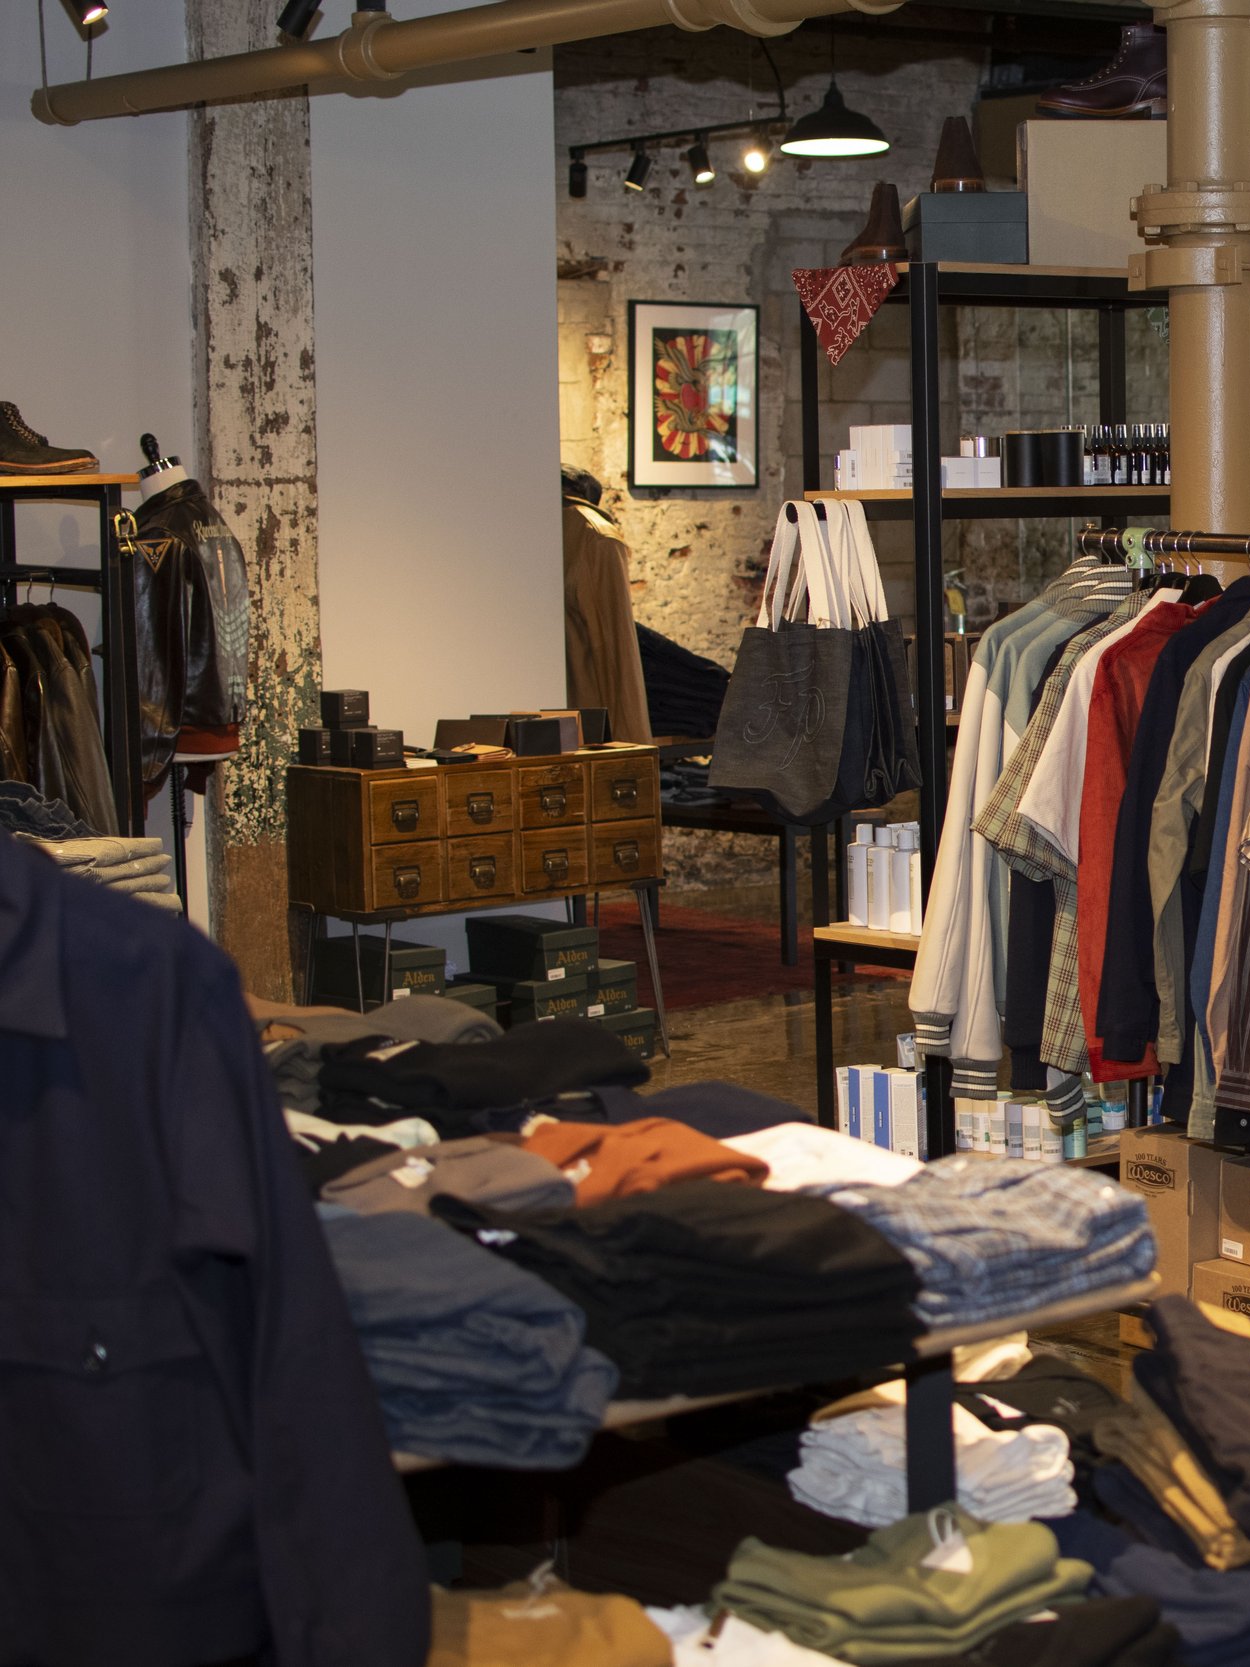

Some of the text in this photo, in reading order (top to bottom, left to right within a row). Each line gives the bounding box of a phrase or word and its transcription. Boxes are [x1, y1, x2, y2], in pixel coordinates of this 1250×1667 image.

[556, 949, 588, 966] Alden
[402, 970, 436, 988] Alden
[596, 988, 628, 1004] Alden
[546, 998, 578, 1013] Alden
[622, 1034, 645, 1047] lden
[1135, 1153, 1168, 1166] 100 YEARS
[1130, 1165, 1171, 1185] Wesco
[1231, 1285, 1242, 1293] 100
